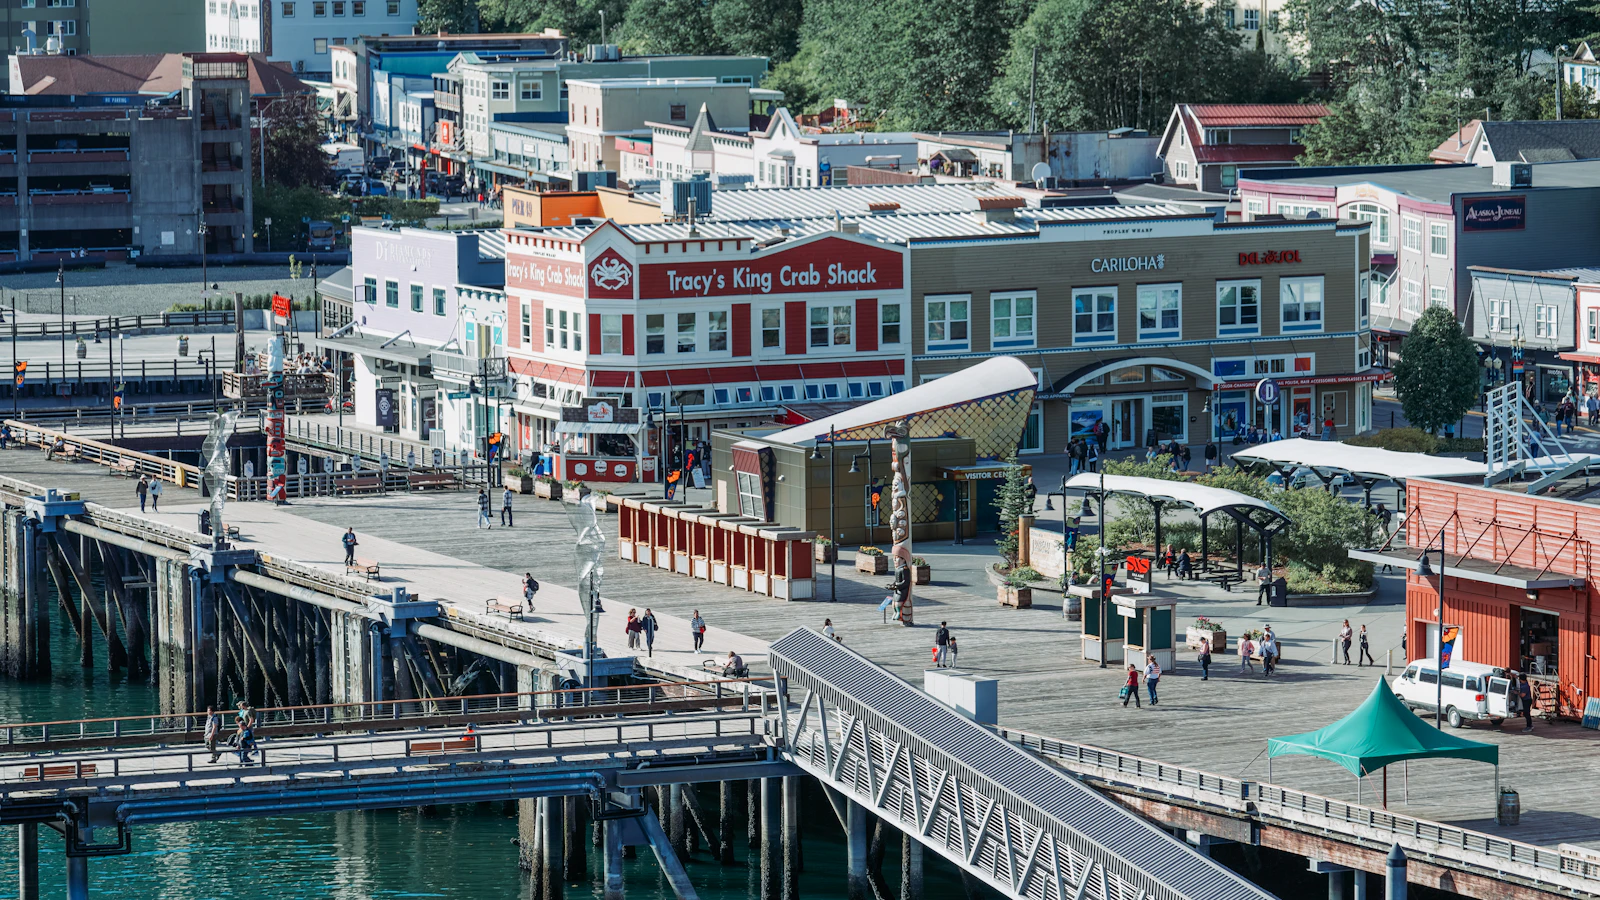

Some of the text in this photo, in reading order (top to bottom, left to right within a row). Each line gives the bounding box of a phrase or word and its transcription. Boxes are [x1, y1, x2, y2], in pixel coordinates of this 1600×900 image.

[1091, 255, 1158, 273] CARILOHA
[1239, 250, 1302, 266] DEL SOL
[507, 259, 584, 288] Tracy's King Crab Shack
[667, 262, 877, 295] Tracy's King Crab Shack
[965, 472, 991, 480] VISITOR
